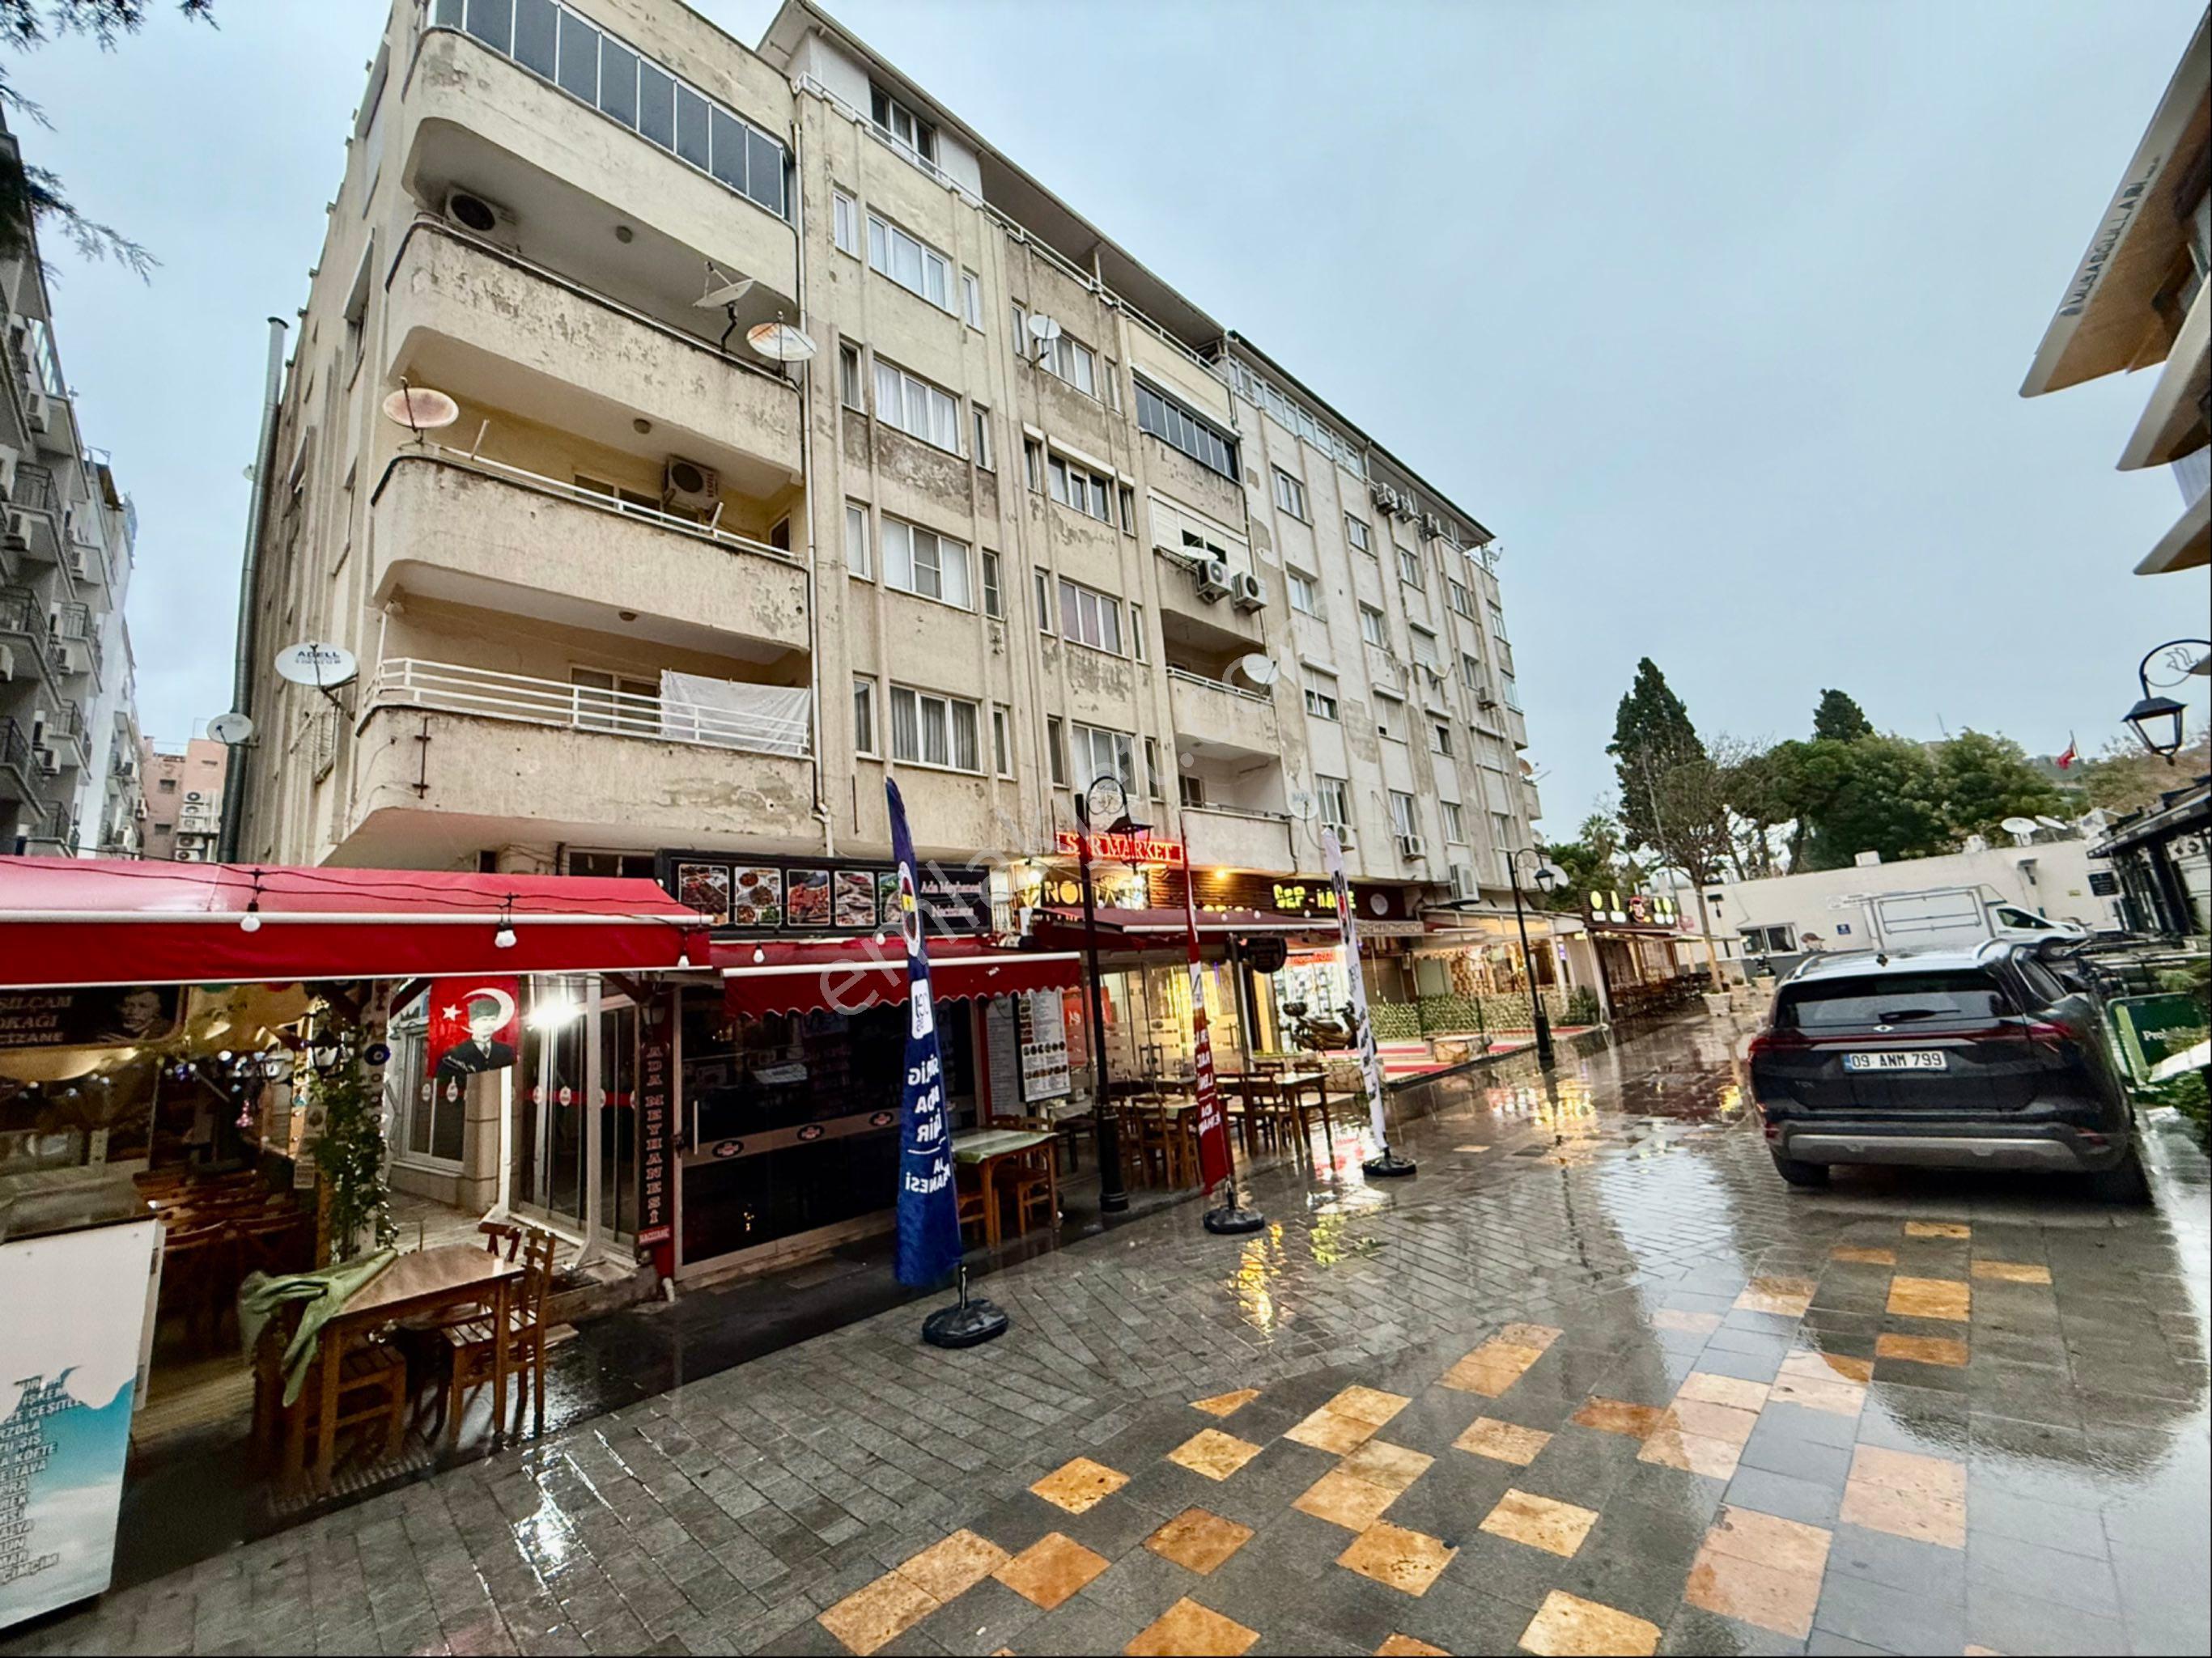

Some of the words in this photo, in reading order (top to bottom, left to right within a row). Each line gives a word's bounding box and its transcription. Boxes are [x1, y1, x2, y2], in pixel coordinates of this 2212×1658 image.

[1852, 1054, 1870, 1068] 09
[1879, 1054, 1907, 1067] ANM
[1912, 1053, 1942, 1066] 799
